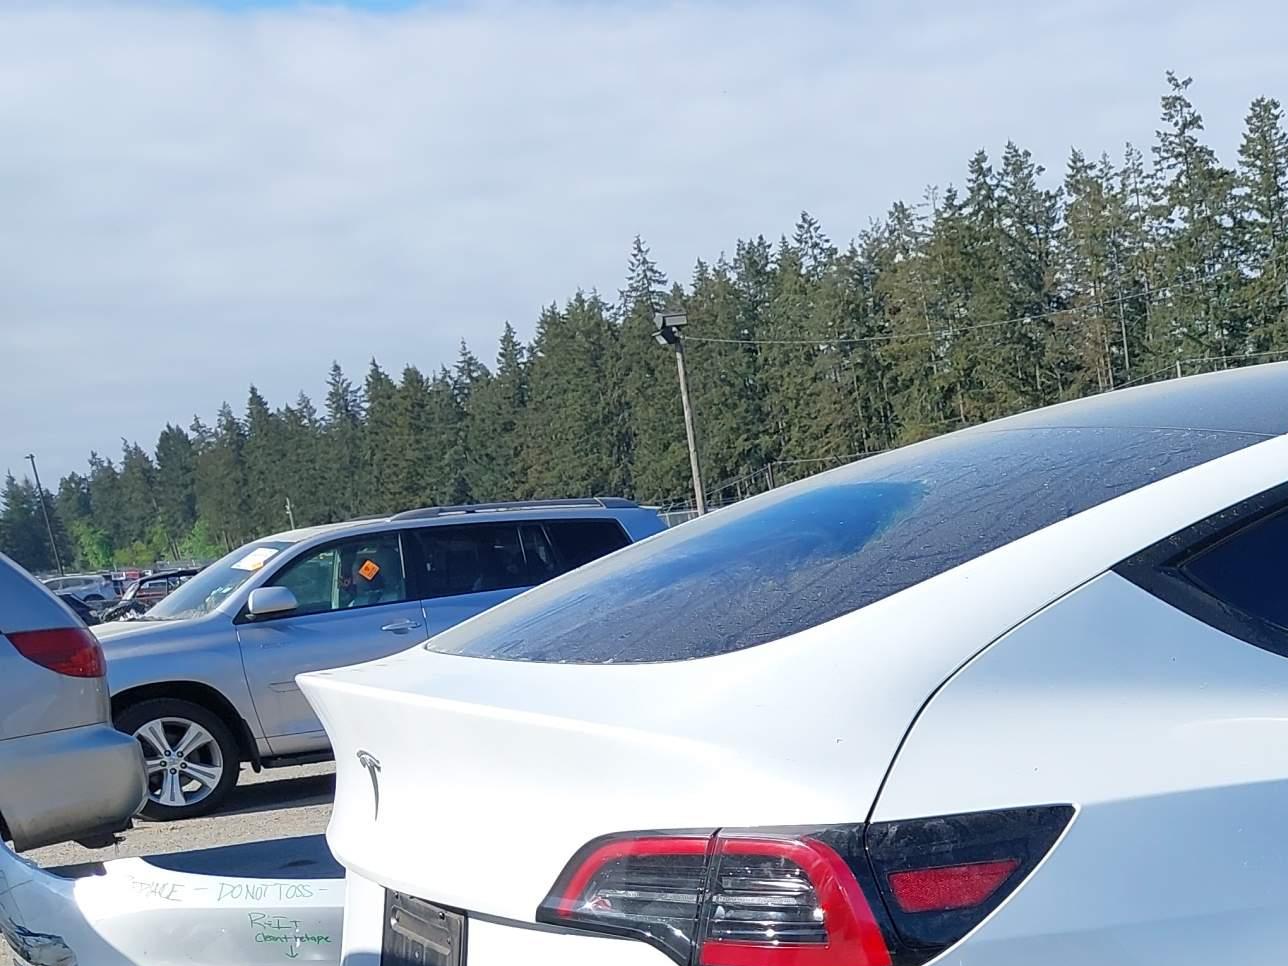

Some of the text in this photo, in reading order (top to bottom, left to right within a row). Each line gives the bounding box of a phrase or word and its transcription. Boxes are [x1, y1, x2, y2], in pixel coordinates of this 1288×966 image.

[217, 882, 243, 902] DO
[245, 883, 275, 901] NOT
[274, 882, 314, 901] TOSS
